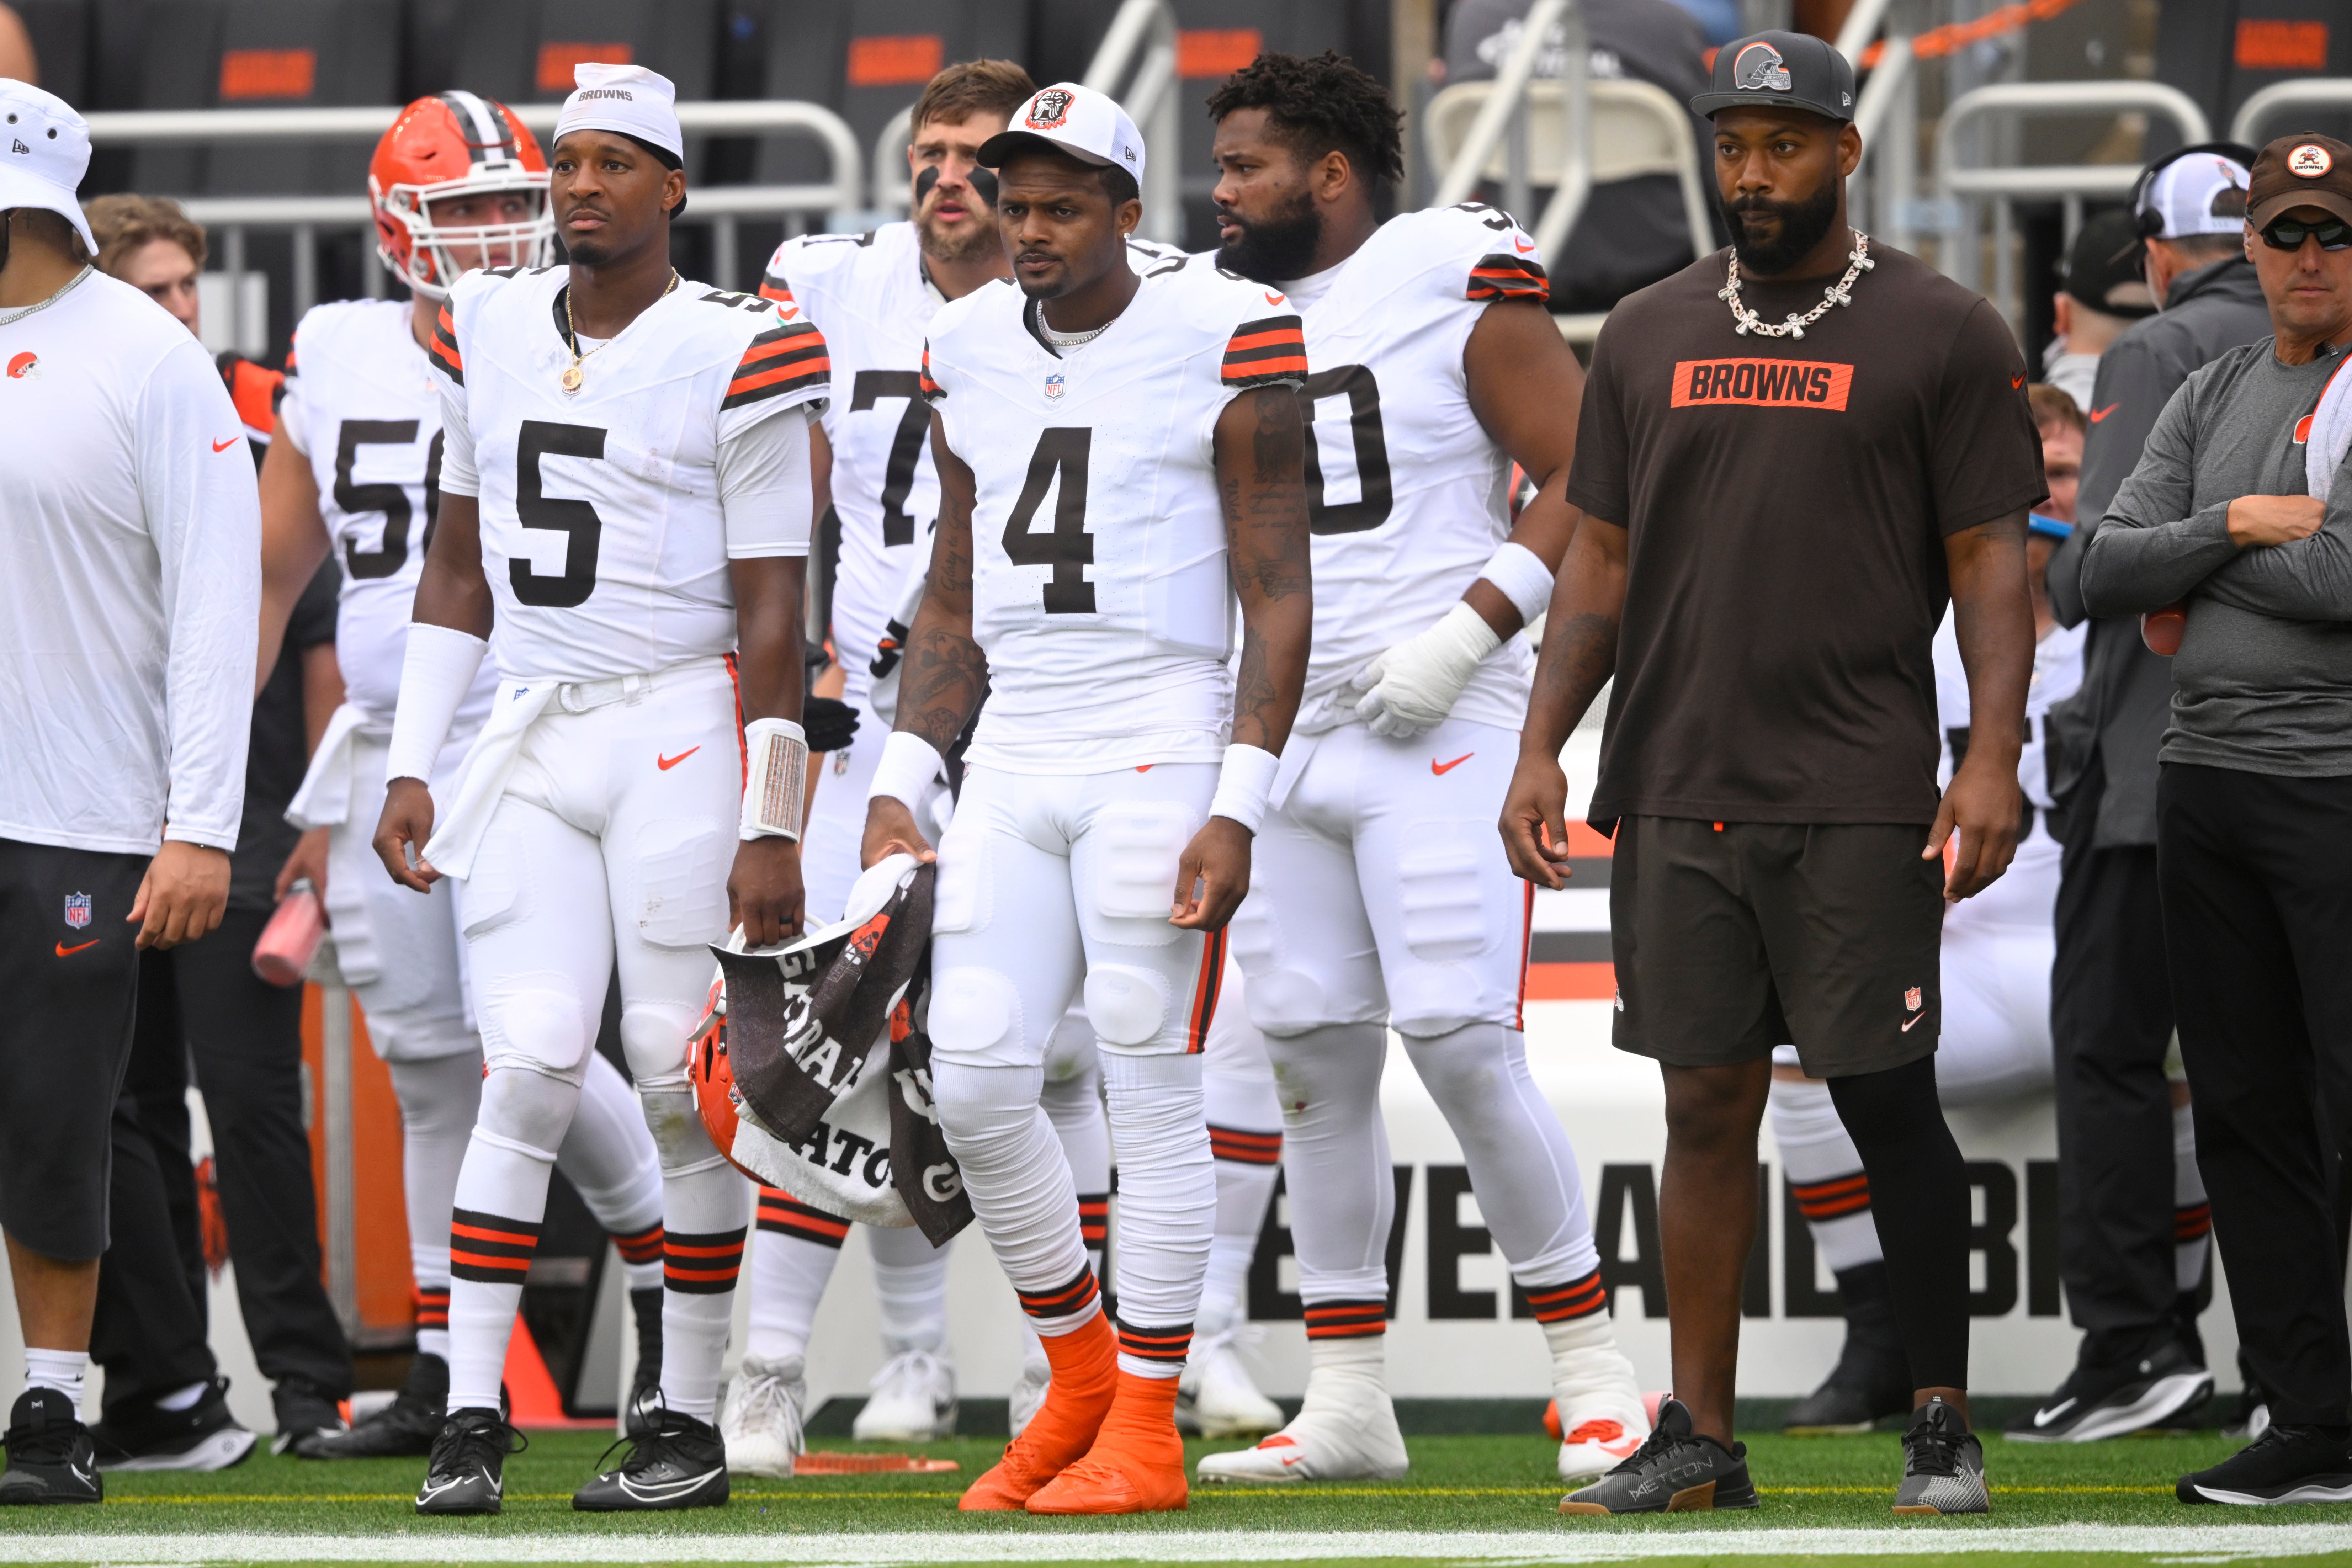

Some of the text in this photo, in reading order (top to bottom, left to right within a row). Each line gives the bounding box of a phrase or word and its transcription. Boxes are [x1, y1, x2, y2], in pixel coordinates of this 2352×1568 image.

[578, 90, 633, 101] BROWNS
[1047, 384, 1061, 395] NFL
[1689, 363, 1832, 402] BROWNS
[509, 420, 608, 608] 5
[1001, 427, 1096, 614] 4
[69, 908, 88, 924] NFL
[1908, 997, 1919, 1007] NFL
[1629, 1456, 1713, 1502] METCON
